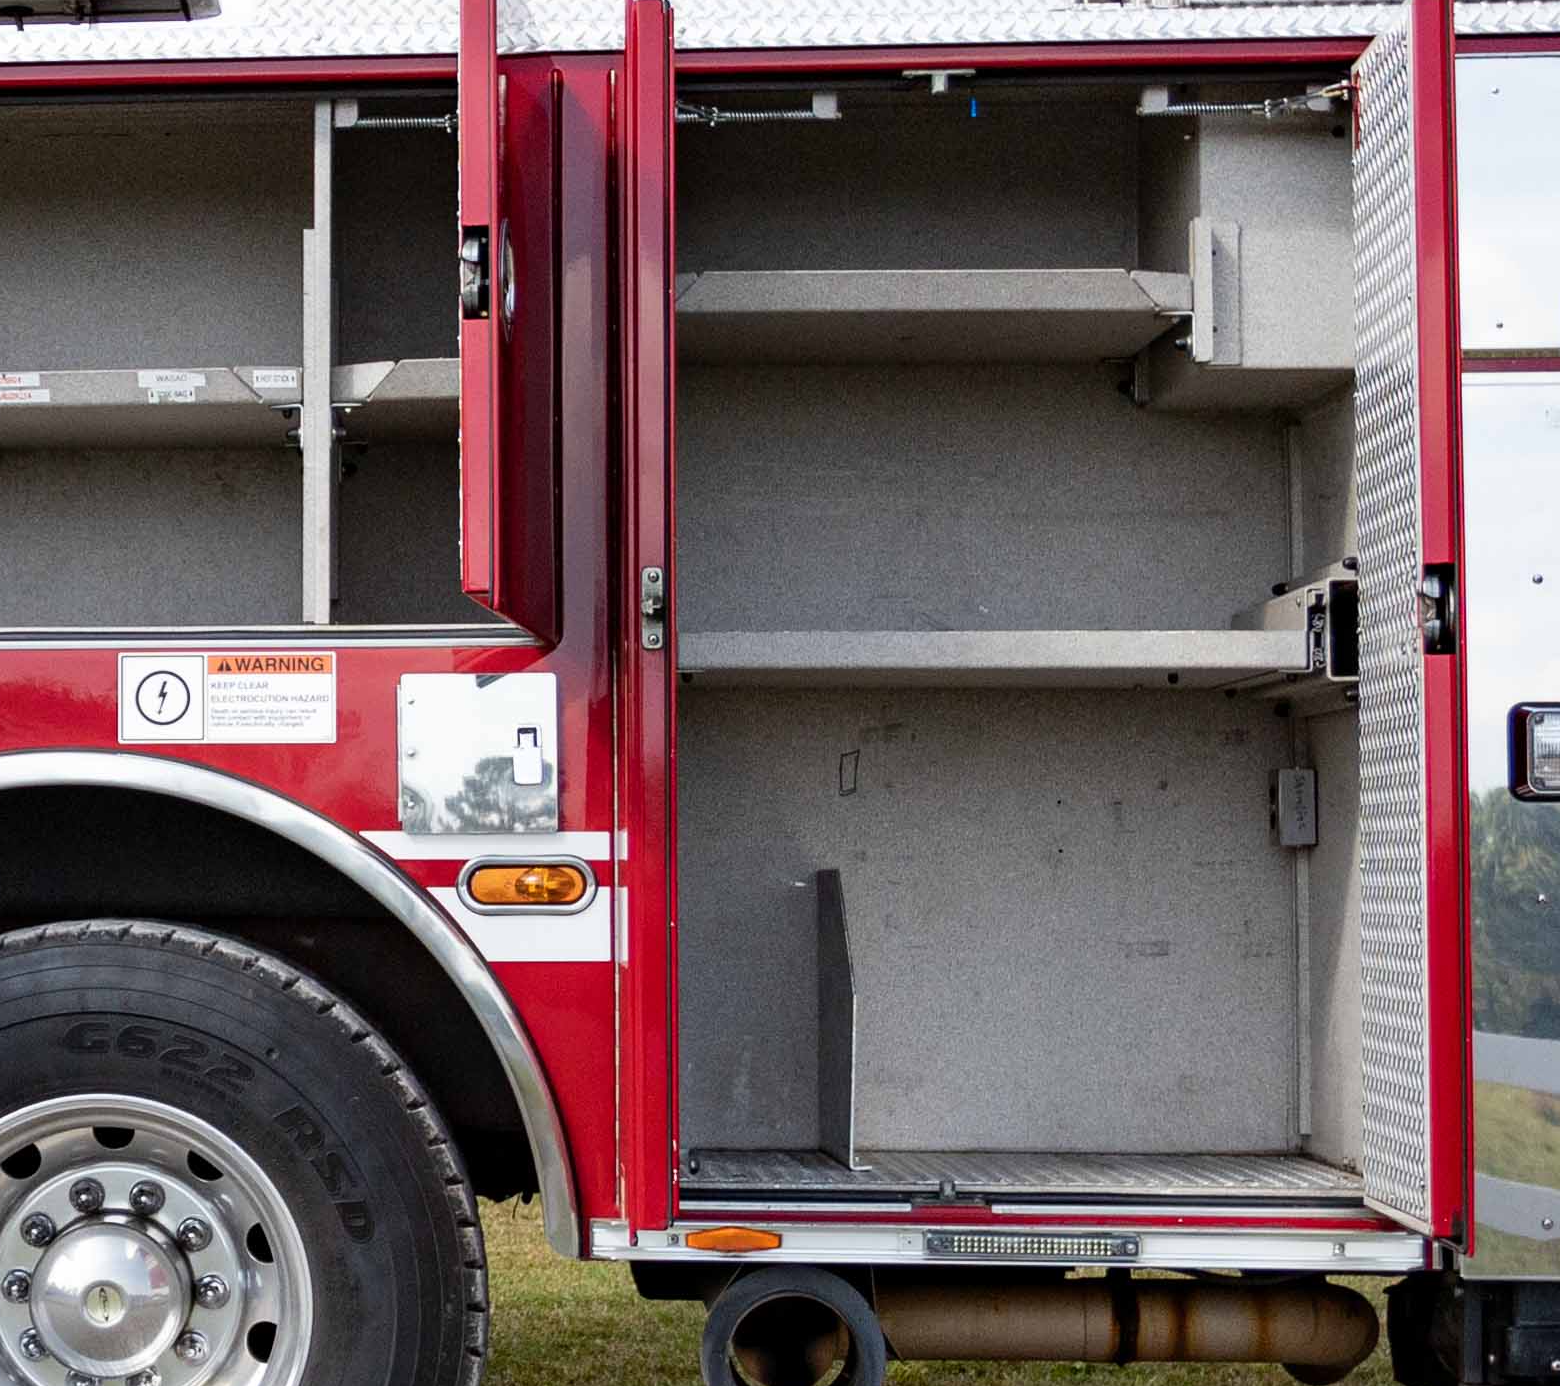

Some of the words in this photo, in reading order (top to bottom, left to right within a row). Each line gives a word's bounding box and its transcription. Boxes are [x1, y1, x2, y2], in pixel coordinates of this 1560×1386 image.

[234, 657, 325, 672] WARNING
[209, 681, 236, 690] KEEP
[238, 681, 270, 690] CLEAR
[210, 694, 289, 703] ELECTROCUTION
[291, 694, 330, 703] HAZARD
[60, 1019, 256, 1094] G622
[269, 1102, 377, 1245] RSD
